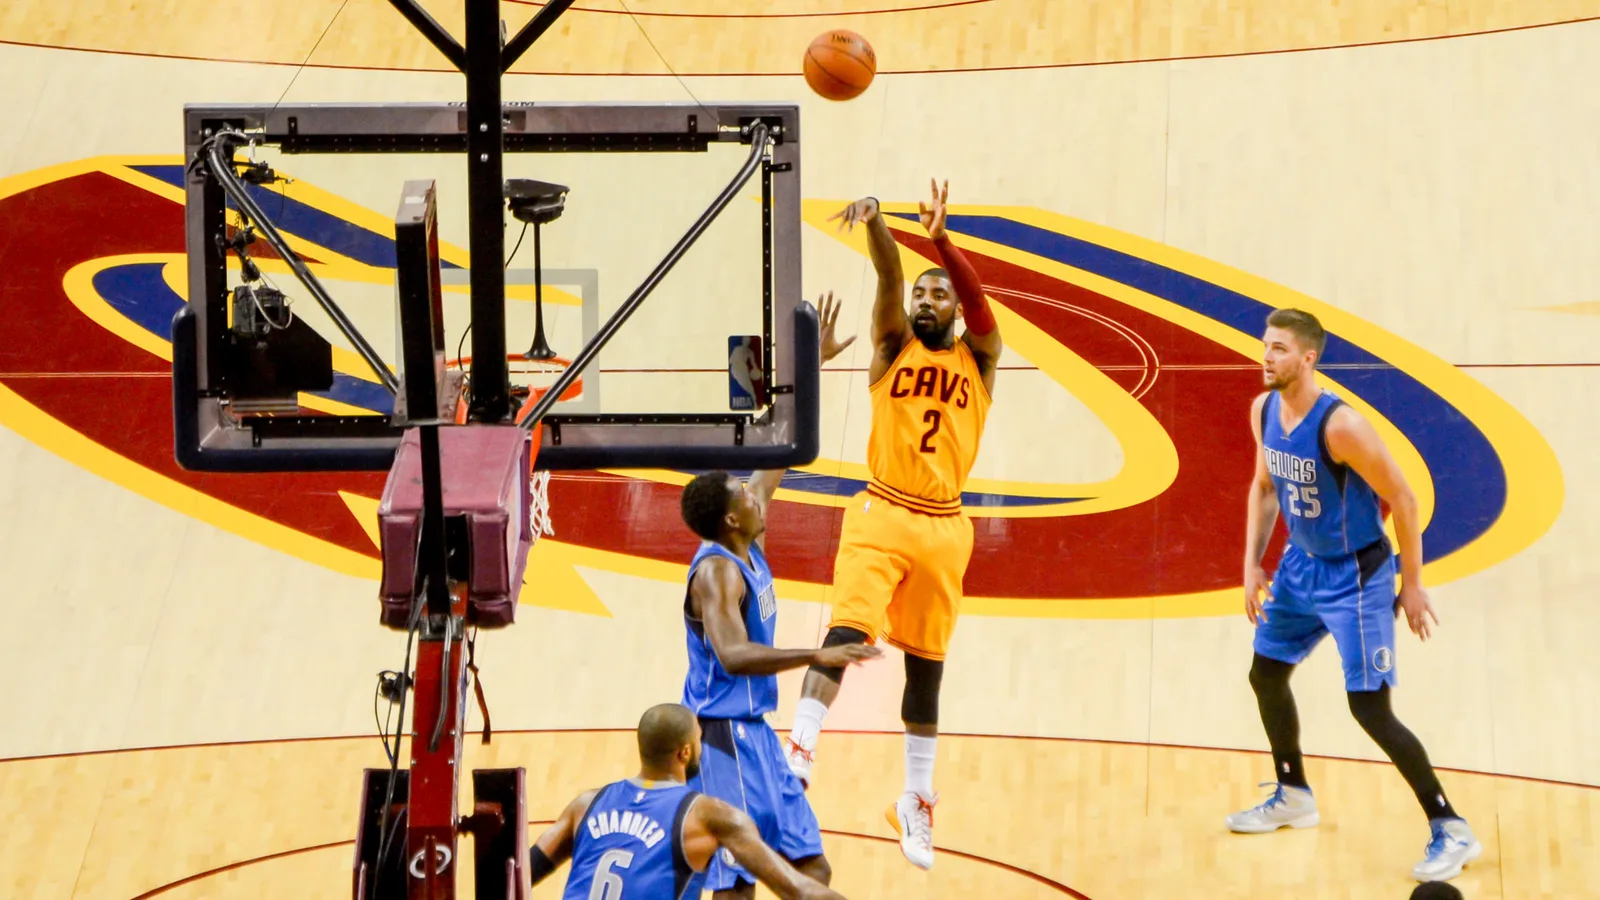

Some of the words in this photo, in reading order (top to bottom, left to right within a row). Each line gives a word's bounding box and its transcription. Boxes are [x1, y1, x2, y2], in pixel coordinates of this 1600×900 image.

[889, 366, 970, 410] CAVS
[919, 409, 941, 454] 2
[1287, 483, 1322, 518] 25
[587, 808, 666, 849] CHANDLER
[588, 849, 634, 900] 6
